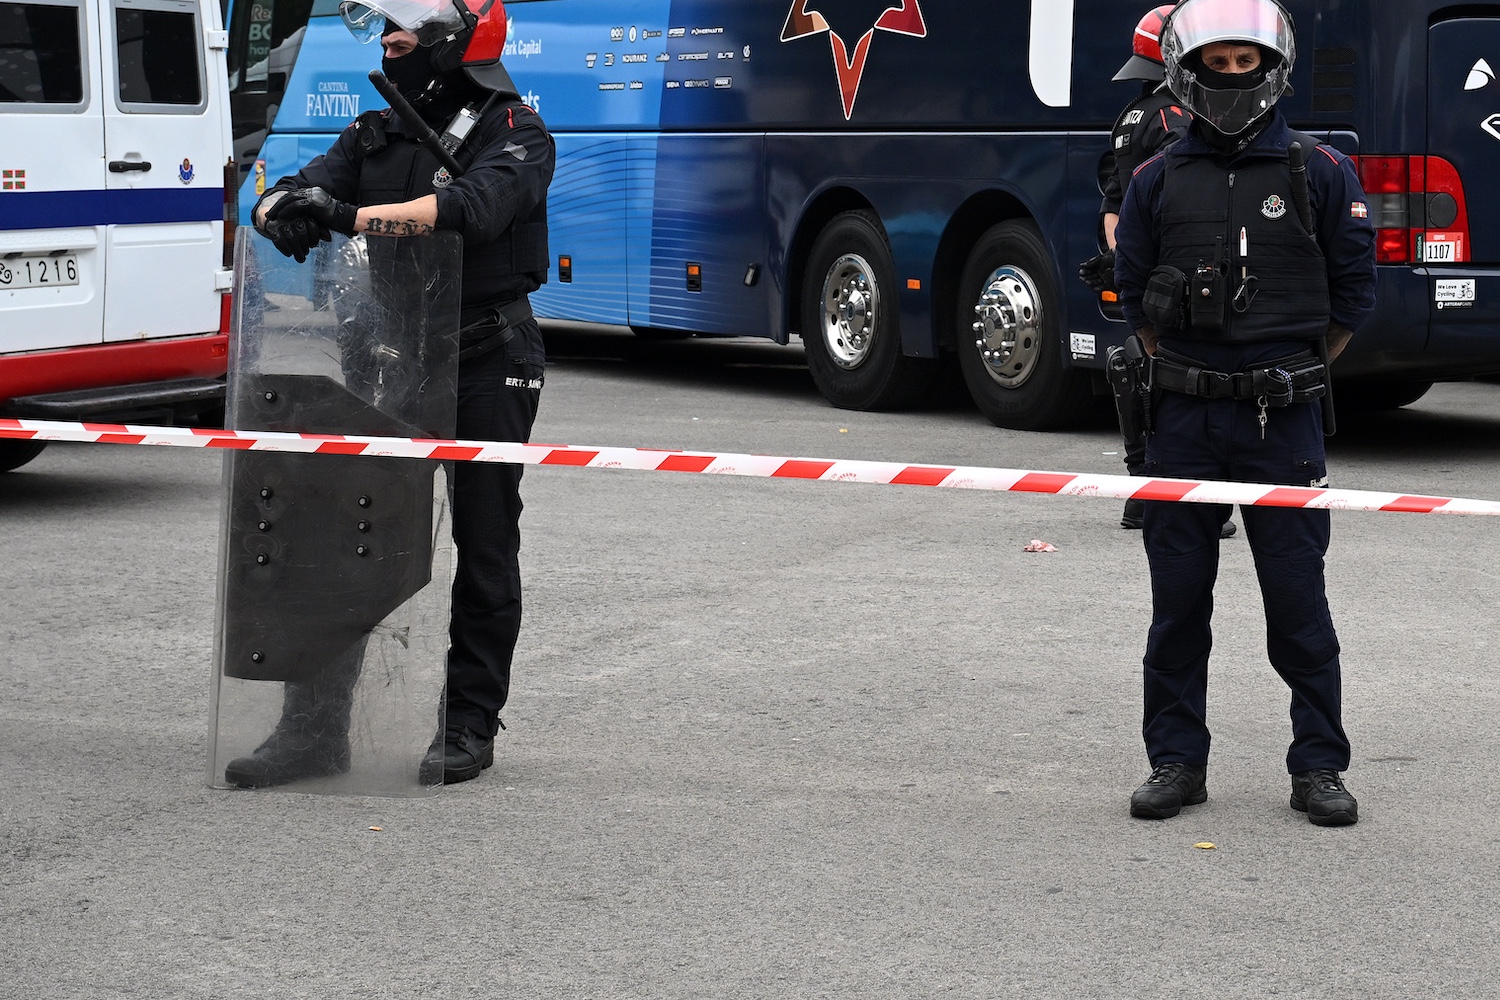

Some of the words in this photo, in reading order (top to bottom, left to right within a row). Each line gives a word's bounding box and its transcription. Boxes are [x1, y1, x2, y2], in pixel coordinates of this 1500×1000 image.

[502, 41, 517, 56] ark
[518, 39, 542, 59] Capital
[318, 82, 348, 92] CANTINA
[306, 94, 360, 118] FANTINI
[1428, 244, 1450, 259] 1107
[25, 259, 77, 283] 1216
